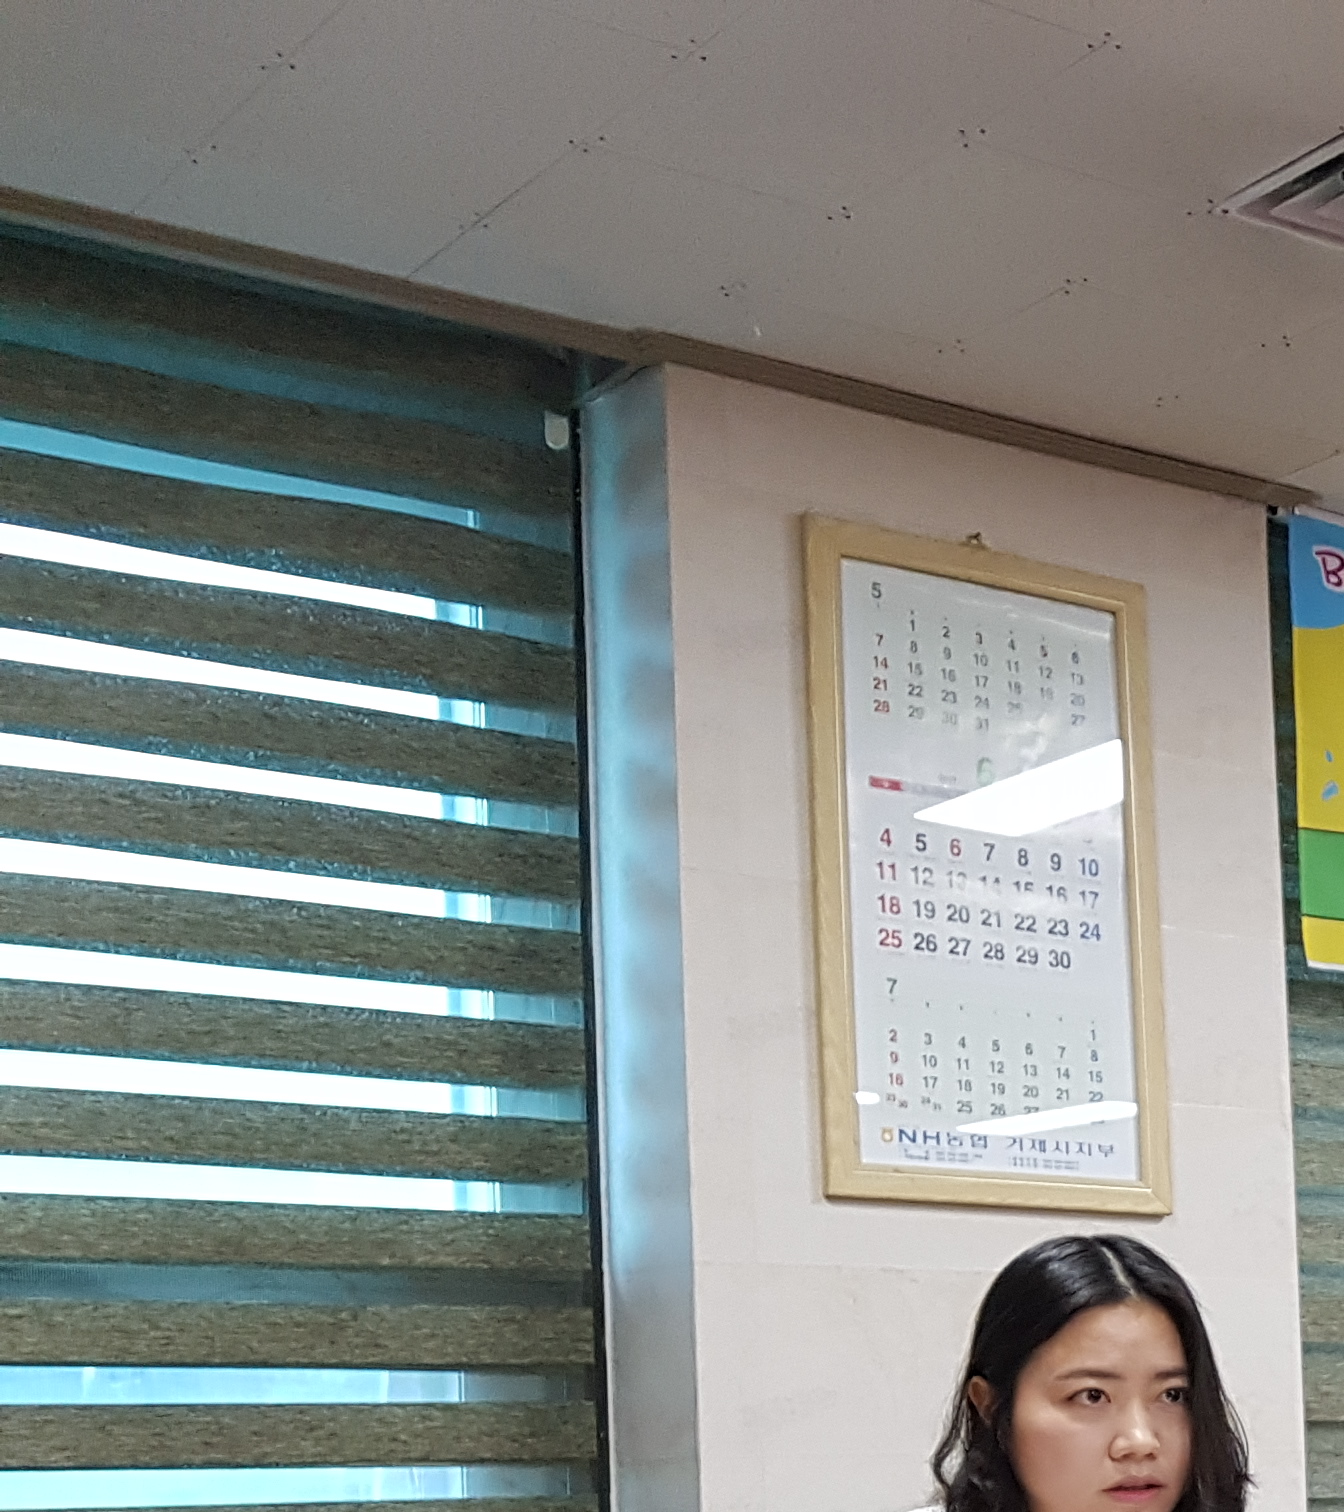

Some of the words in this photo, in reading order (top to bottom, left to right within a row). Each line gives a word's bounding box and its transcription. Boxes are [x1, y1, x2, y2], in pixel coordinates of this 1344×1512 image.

[871, 582, 882, 599] 5
[942, 626, 950, 639] 2
[876, 634, 884, 646] 7
[973, 653, 988, 667] 10
[1007, 660, 1019, 673] 11
[1039, 665, 1053, 679] 12
[874, 656, 889, 669] 14
[975, 675, 988, 688] 17
[873, 677, 887, 691] 21
[908, 684, 923, 698] 22
[977, 757, 994, 785] 6
[880, 828, 892, 847] 4
[915, 833, 927, 852] 5
[950, 838, 962, 857] 6
[983, 843, 995, 861] 7
[1018, 848, 1029, 867] 8
[1050, 853, 1061, 872] 9
[1078, 857, 1099, 877] 10
[876, 861, 896, 880] 11
[910, 866, 934, 887] 12
[1079, 890, 1099, 909] 17
[877, 894, 901, 915] 18
[912, 899, 936, 919] 19
[946, 903, 970, 924] 20
[980, 908, 1001, 928] 21
[1014, 913, 1037, 933] 22
[1047, 917, 1069, 937] 23
[1079, 921, 1101, 942] 24
[879, 928, 902, 948] 25
[913, 932, 937, 953] 26
[948, 936, 971, 956] 27
[983, 941, 1005, 961] 28
[1015, 945, 1039, 965] 29
[1048, 949, 1071, 969] 30
[886, 977, 898, 994] 7
[888, 1028, 898, 1042] 2
[924, 1032, 932, 1045] 3
[992, 1039, 1000, 1052] 5
[1025, 1043, 1033, 1056] 6
[1057, 1045, 1066, 1058] 7
[1090, 1049, 1098, 1062] 8
[922, 1054, 937, 1068] 10
[957, 1058, 969, 1070] 11
[990, 1060, 1004, 1074] 12
[1023, 1063, 1038, 1077] 13
[1056, 1067, 1070, 1080] 14
[1088, 1071, 1103, 1084] 15
[922, 1075, 938, 1089] 17
[957, 1079, 972, 1092] 18
[991, 1082, 1006, 1095] 19
[1023, 1085, 1039, 1098] 20
[1056, 1088, 1070, 1101] 21
[956, 1100, 973, 1114] 25
